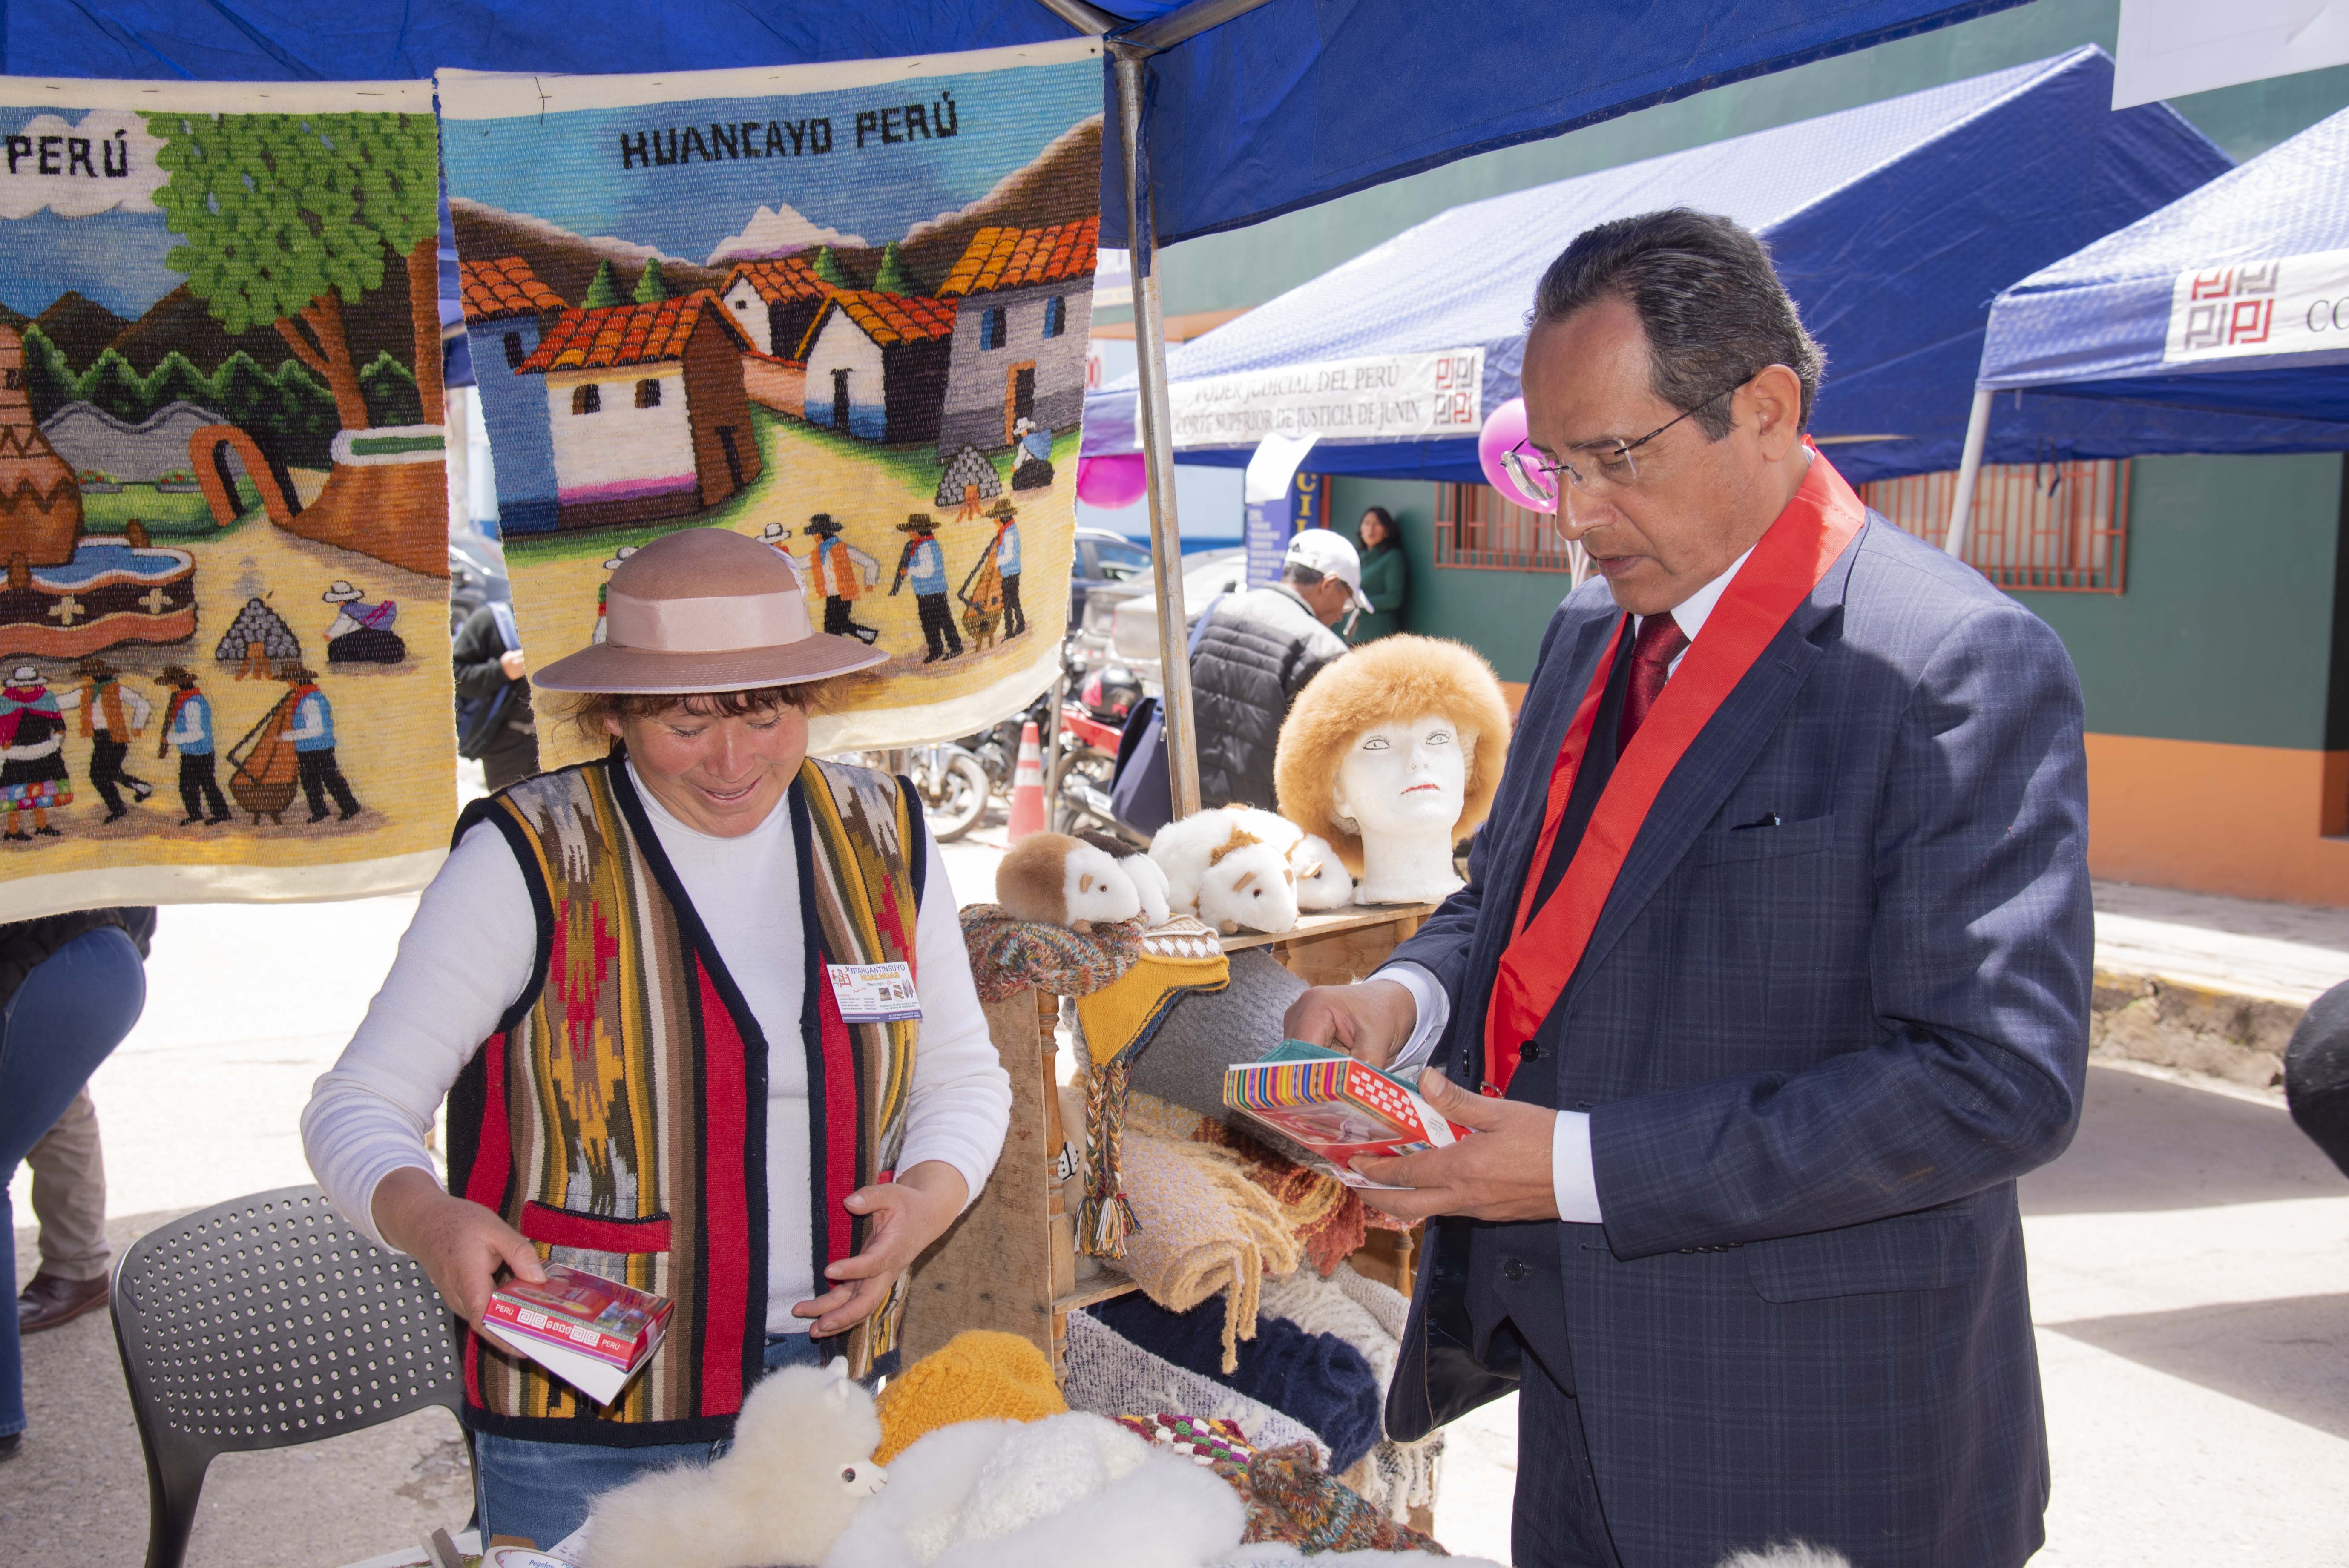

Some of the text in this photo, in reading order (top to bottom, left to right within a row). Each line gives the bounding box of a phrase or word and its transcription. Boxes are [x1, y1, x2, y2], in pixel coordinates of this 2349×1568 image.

[620, 91, 958, 169] HUANCAYO PERÚ
[5, 129, 128, 178] PERÚ
[1243, 373, 1311, 404] JUDICIAL
[1318, 369, 1348, 392] DEL
[1354, 358, 1400, 390] PERÚ
[1214, 409, 1272, 432] SUPERIOR
[1277, 408, 1294, 428] DE
[1298, 404, 1353, 433] JUSTICIA
[1358, 403, 1377, 425] DE
[495, 1304, 514, 1315] PERÚ
[601, 1339, 621, 1350] PERÚ
